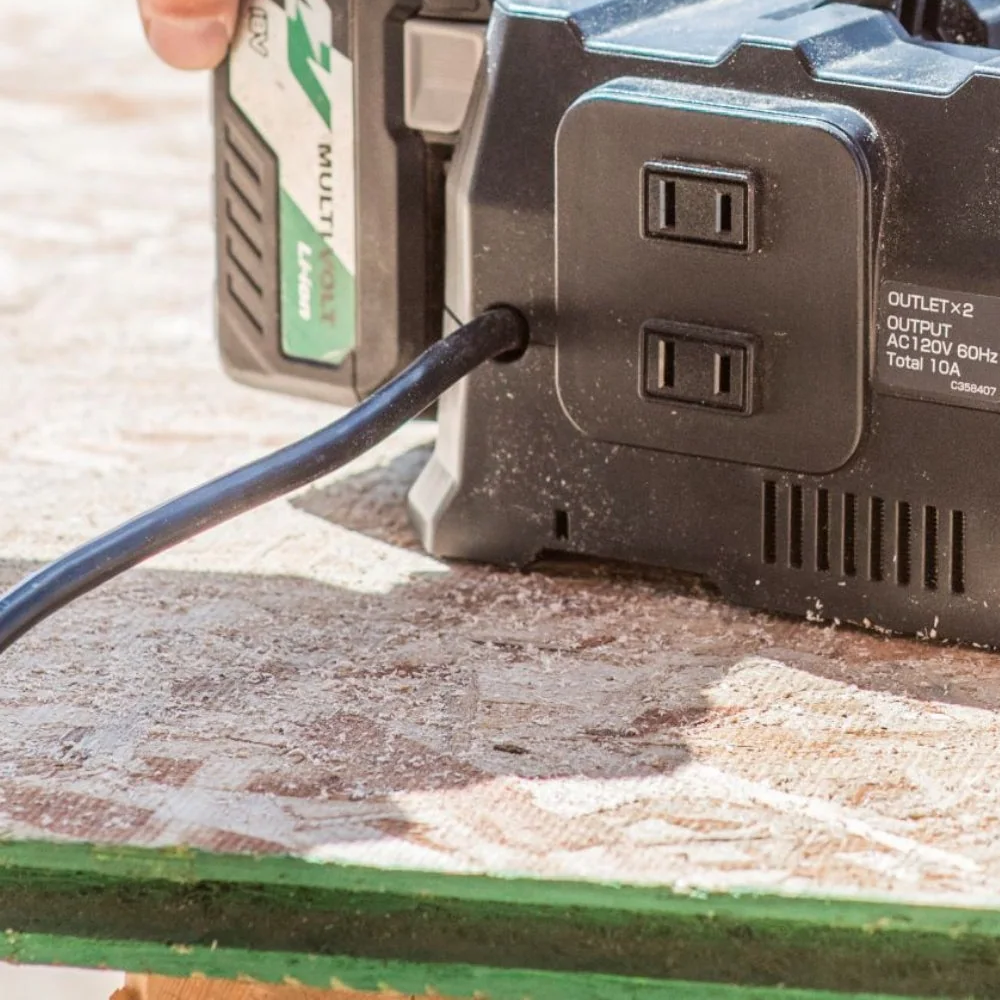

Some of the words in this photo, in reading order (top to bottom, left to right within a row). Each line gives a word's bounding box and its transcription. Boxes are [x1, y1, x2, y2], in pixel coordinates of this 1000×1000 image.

[318, 143, 333, 242] MULTI
[318, 249, 337, 327] VOLT
[886, 315, 953, 339] OUTPUT
[886, 333, 953, 356] AC120V
[957, 344, 998, 364] 60Hz
[886, 351, 924, 371] Total
[931, 358, 961, 377] 10A
[950, 380, 997, 396] C358407
